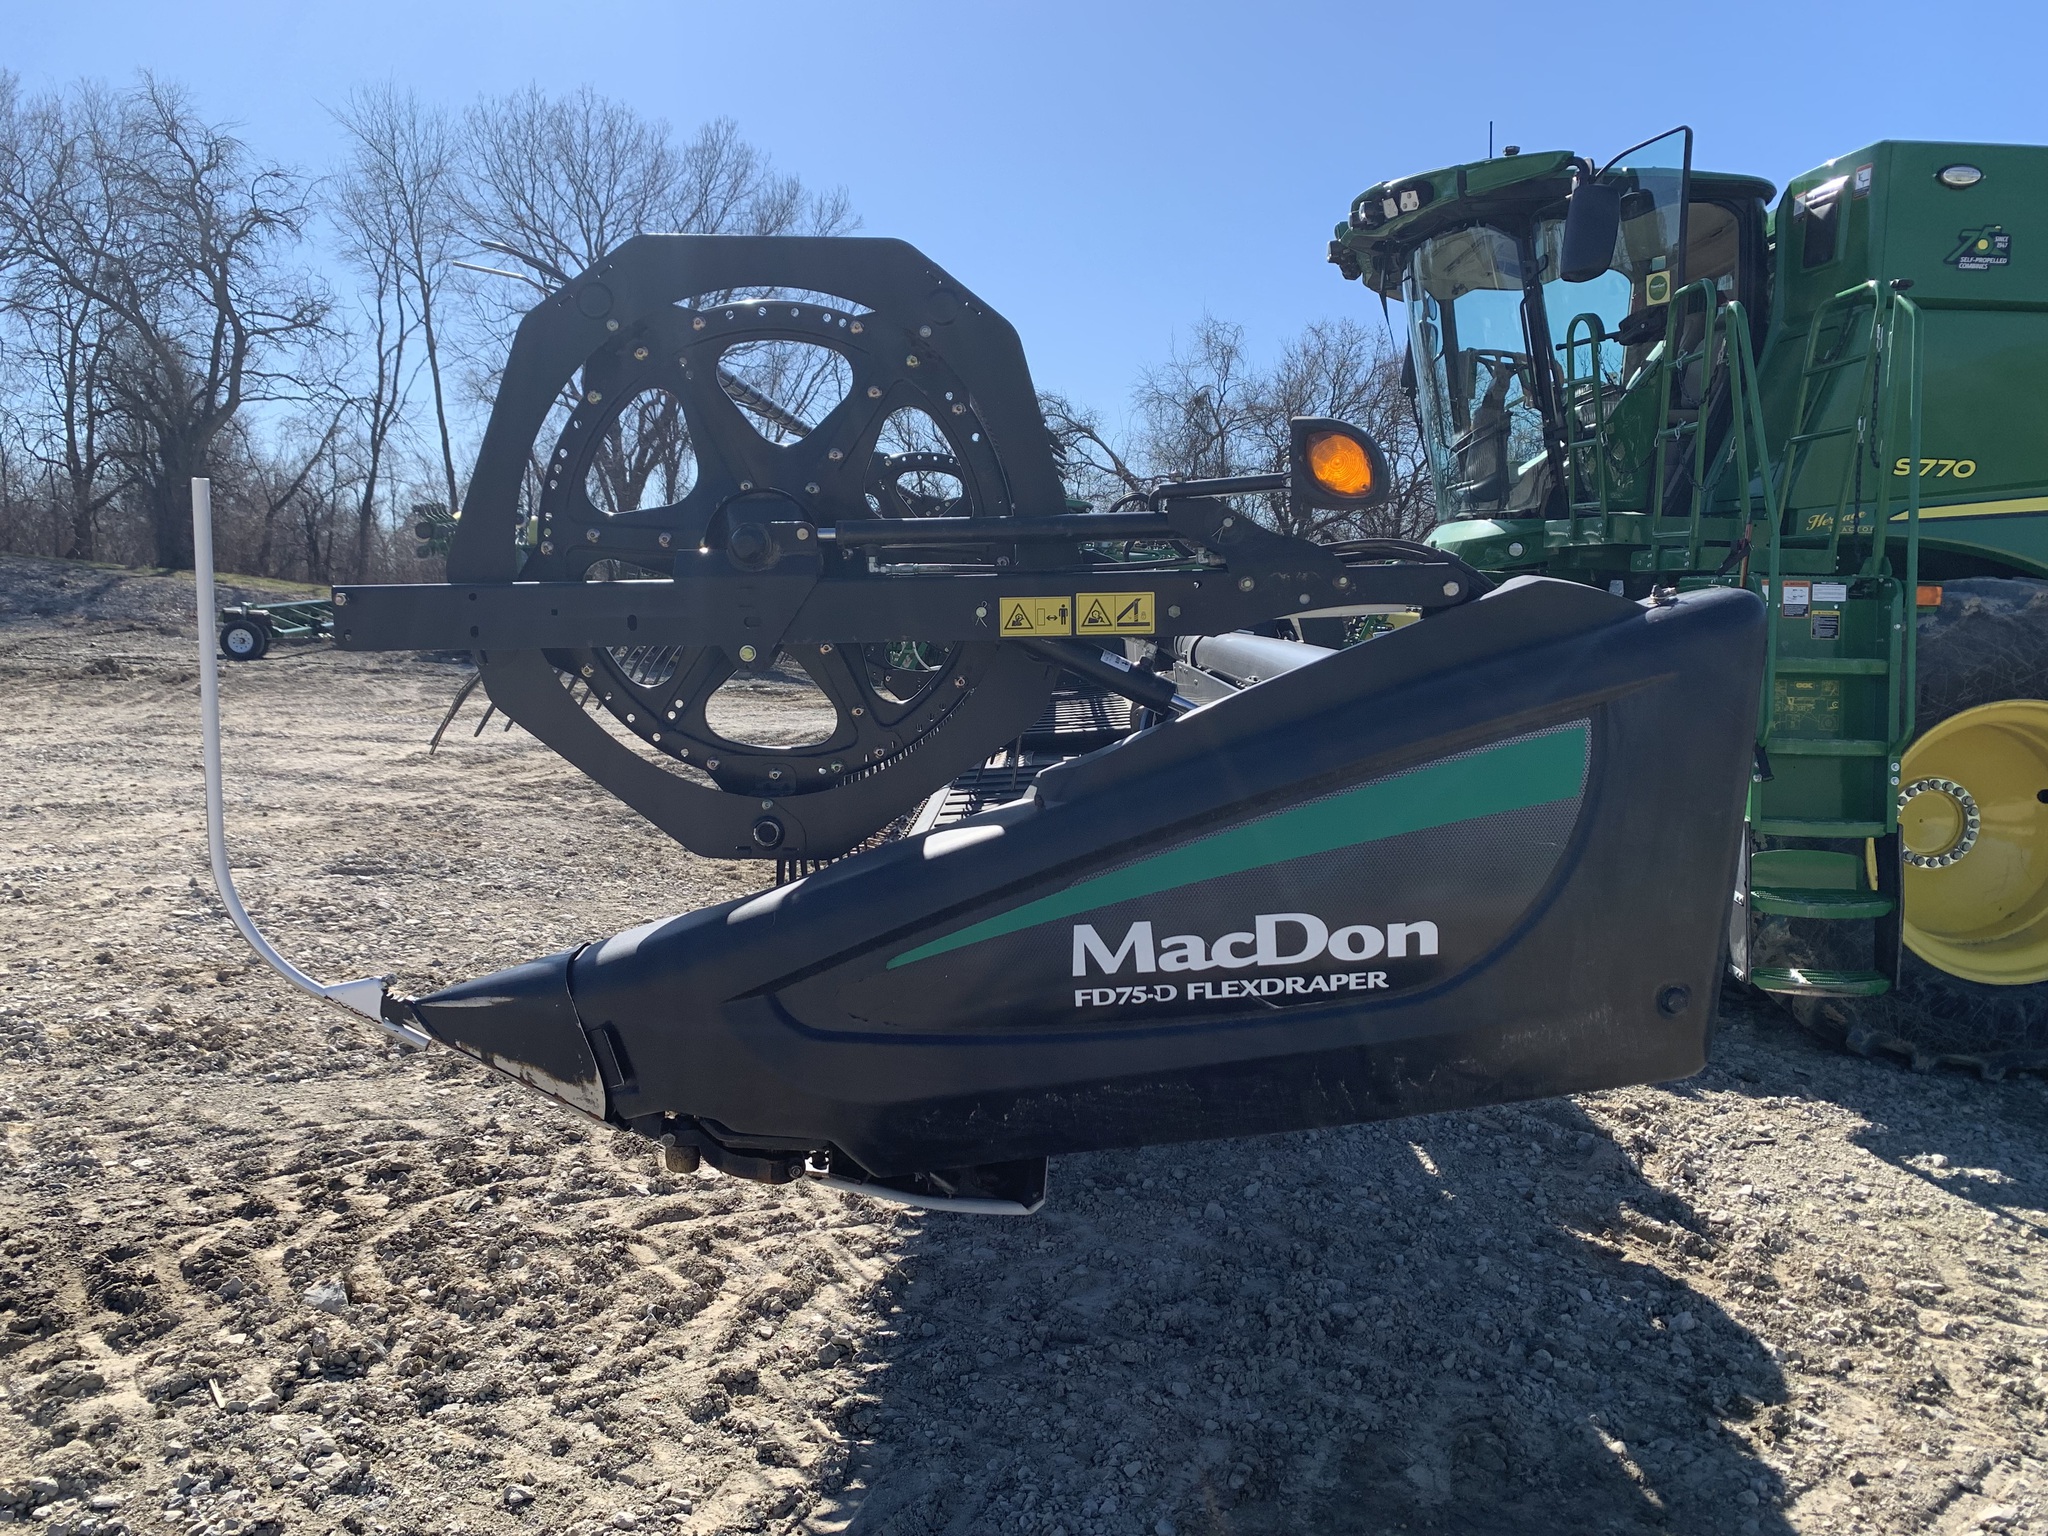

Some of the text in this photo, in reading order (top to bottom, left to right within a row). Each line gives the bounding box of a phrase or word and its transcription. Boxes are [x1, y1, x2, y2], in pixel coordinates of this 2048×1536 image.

[1958, 262, 1988, 270] COMBINES
[1960, 256, 2008, 264] SELF-PROPELLED
[1893, 457, 1977, 479] S770
[1072, 912, 1439, 977] MacDon
[1074, 971, 1390, 1008] FD75-D FLEXDRAPER
